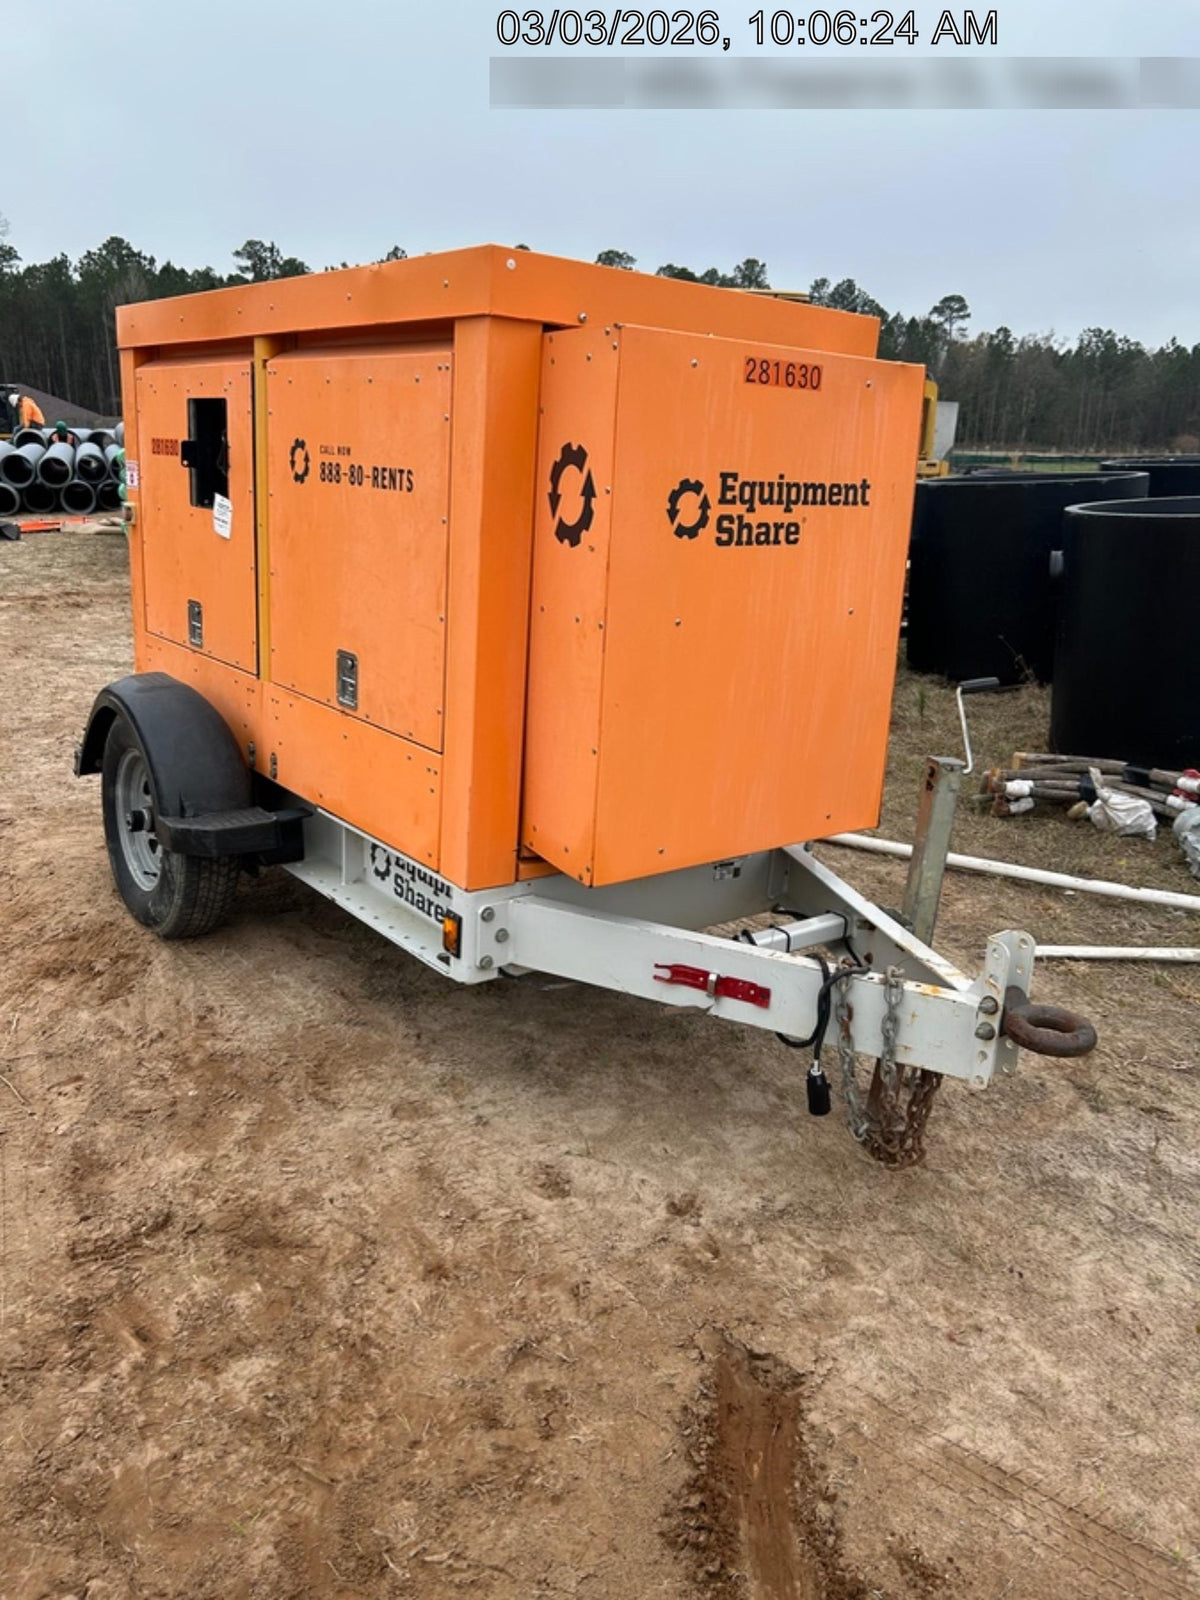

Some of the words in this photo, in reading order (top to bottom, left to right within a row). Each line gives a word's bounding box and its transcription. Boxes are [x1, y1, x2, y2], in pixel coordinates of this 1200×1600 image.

[745, 357, 823, 390] 281630
[320, 461, 414, 493] 888-80-RENTS
[717, 471, 871, 513] Equipment
[715, 514, 801, 546] Share
[393, 872, 446, 924] Share
